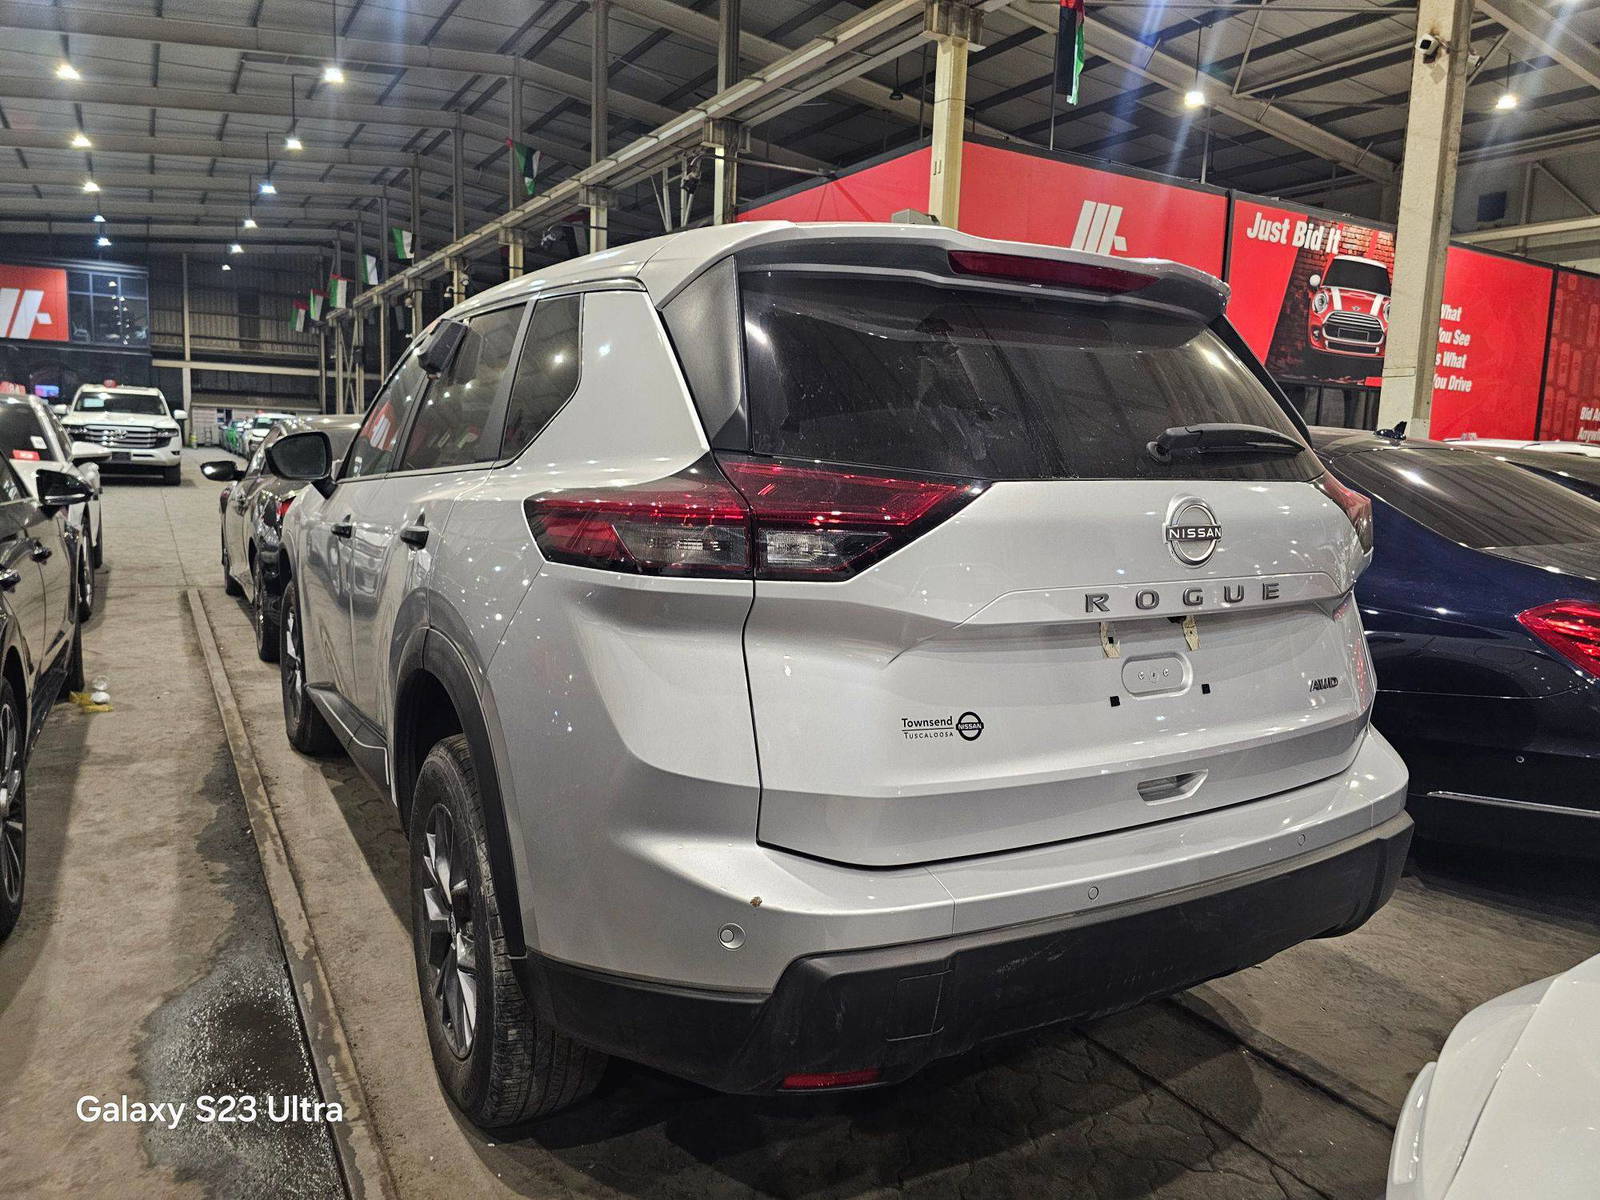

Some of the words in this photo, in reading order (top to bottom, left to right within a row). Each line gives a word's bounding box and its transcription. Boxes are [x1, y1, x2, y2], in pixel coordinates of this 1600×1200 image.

[1247, 211, 1290, 245] Just
[1292, 220, 1325, 251] Bid
[1325, 227, 1341, 254] It
[1453, 329, 1470, 346] See
[1443, 351, 1467, 369] What
[1448, 375, 1472, 392] Drive
[1169, 527, 1222, 539] NISSAN
[1084, 582, 1280, 613] ROGUE
[1309, 677, 1339, 692] AWD
[901, 715, 953, 729] Townsend
[957, 723, 982, 731] NISSAN
[903, 731, 954, 740] TUSCALOOSA
